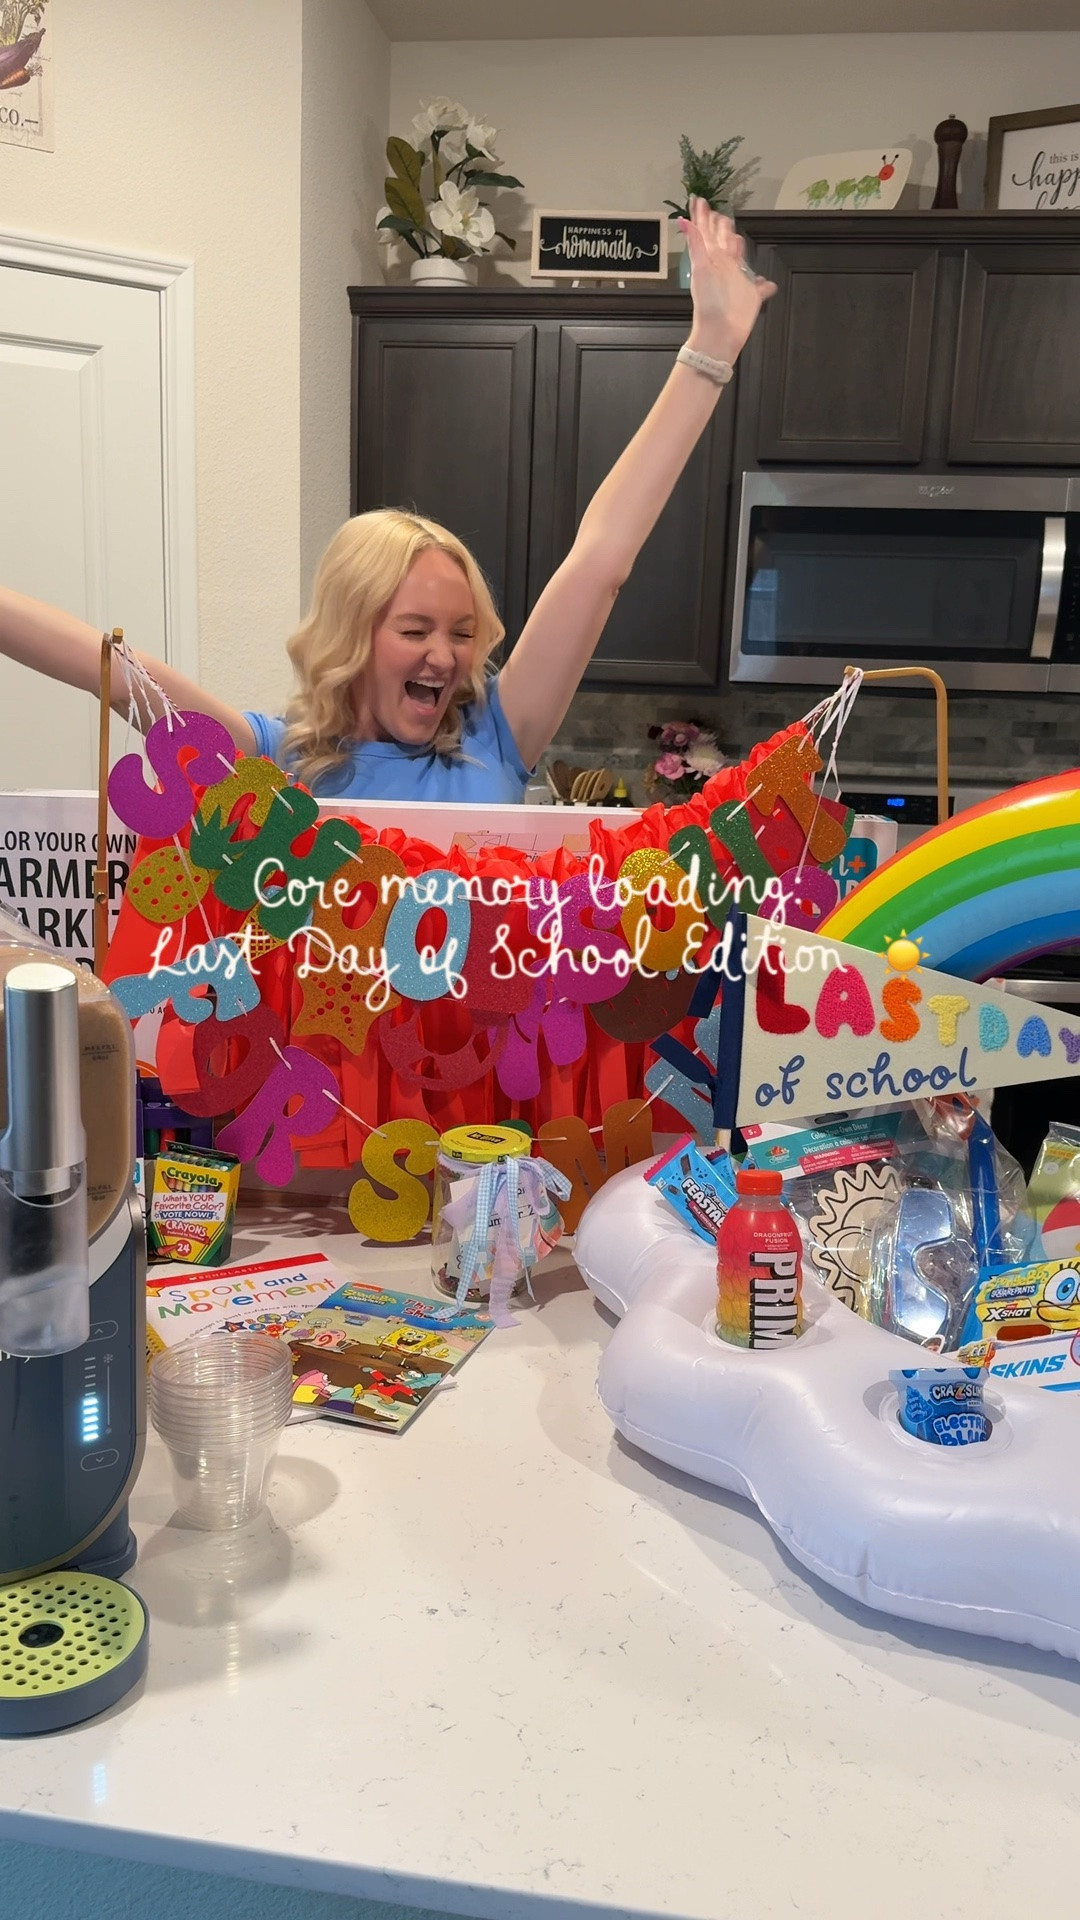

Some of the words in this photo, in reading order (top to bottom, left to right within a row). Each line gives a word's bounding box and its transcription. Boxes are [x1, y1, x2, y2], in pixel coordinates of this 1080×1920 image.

[1049, 153, 1068, 164] this
[1070, 151, 1080, 162] is
[567, 226, 612, 236] HAPPINESS
[615, 228, 624, 236] IS
[540, 225, 659, 260] homemade
[34, 832, 86, 852] YOUR
[756, 944, 970, 1047] LAST
[977, 1002, 1080, 1064] DAY
[755, 1055, 805, 1107] of
[826, 1046, 977, 1100] school
[166, 1166, 218, 1186] Crayola
[154, 1201, 192, 1211] Favorite
[193, 1202, 225, 1211] Color?
[162, 1194, 188, 1203] What's
[189, 1193, 215, 1202] YOUR
[162, 1211, 183, 1219] VOTE
[165, 1220, 207, 1237] CRAYONS
[177, 1243, 191, 1253] 24
[168, 1279, 257, 1302] Sport
[264, 1272, 308, 1287] and
[990, 1285, 1036, 1298] SQUAREPANTS
[157, 1277, 336, 1319] Movement
[989, 1353, 1068, 1379] SKINS
